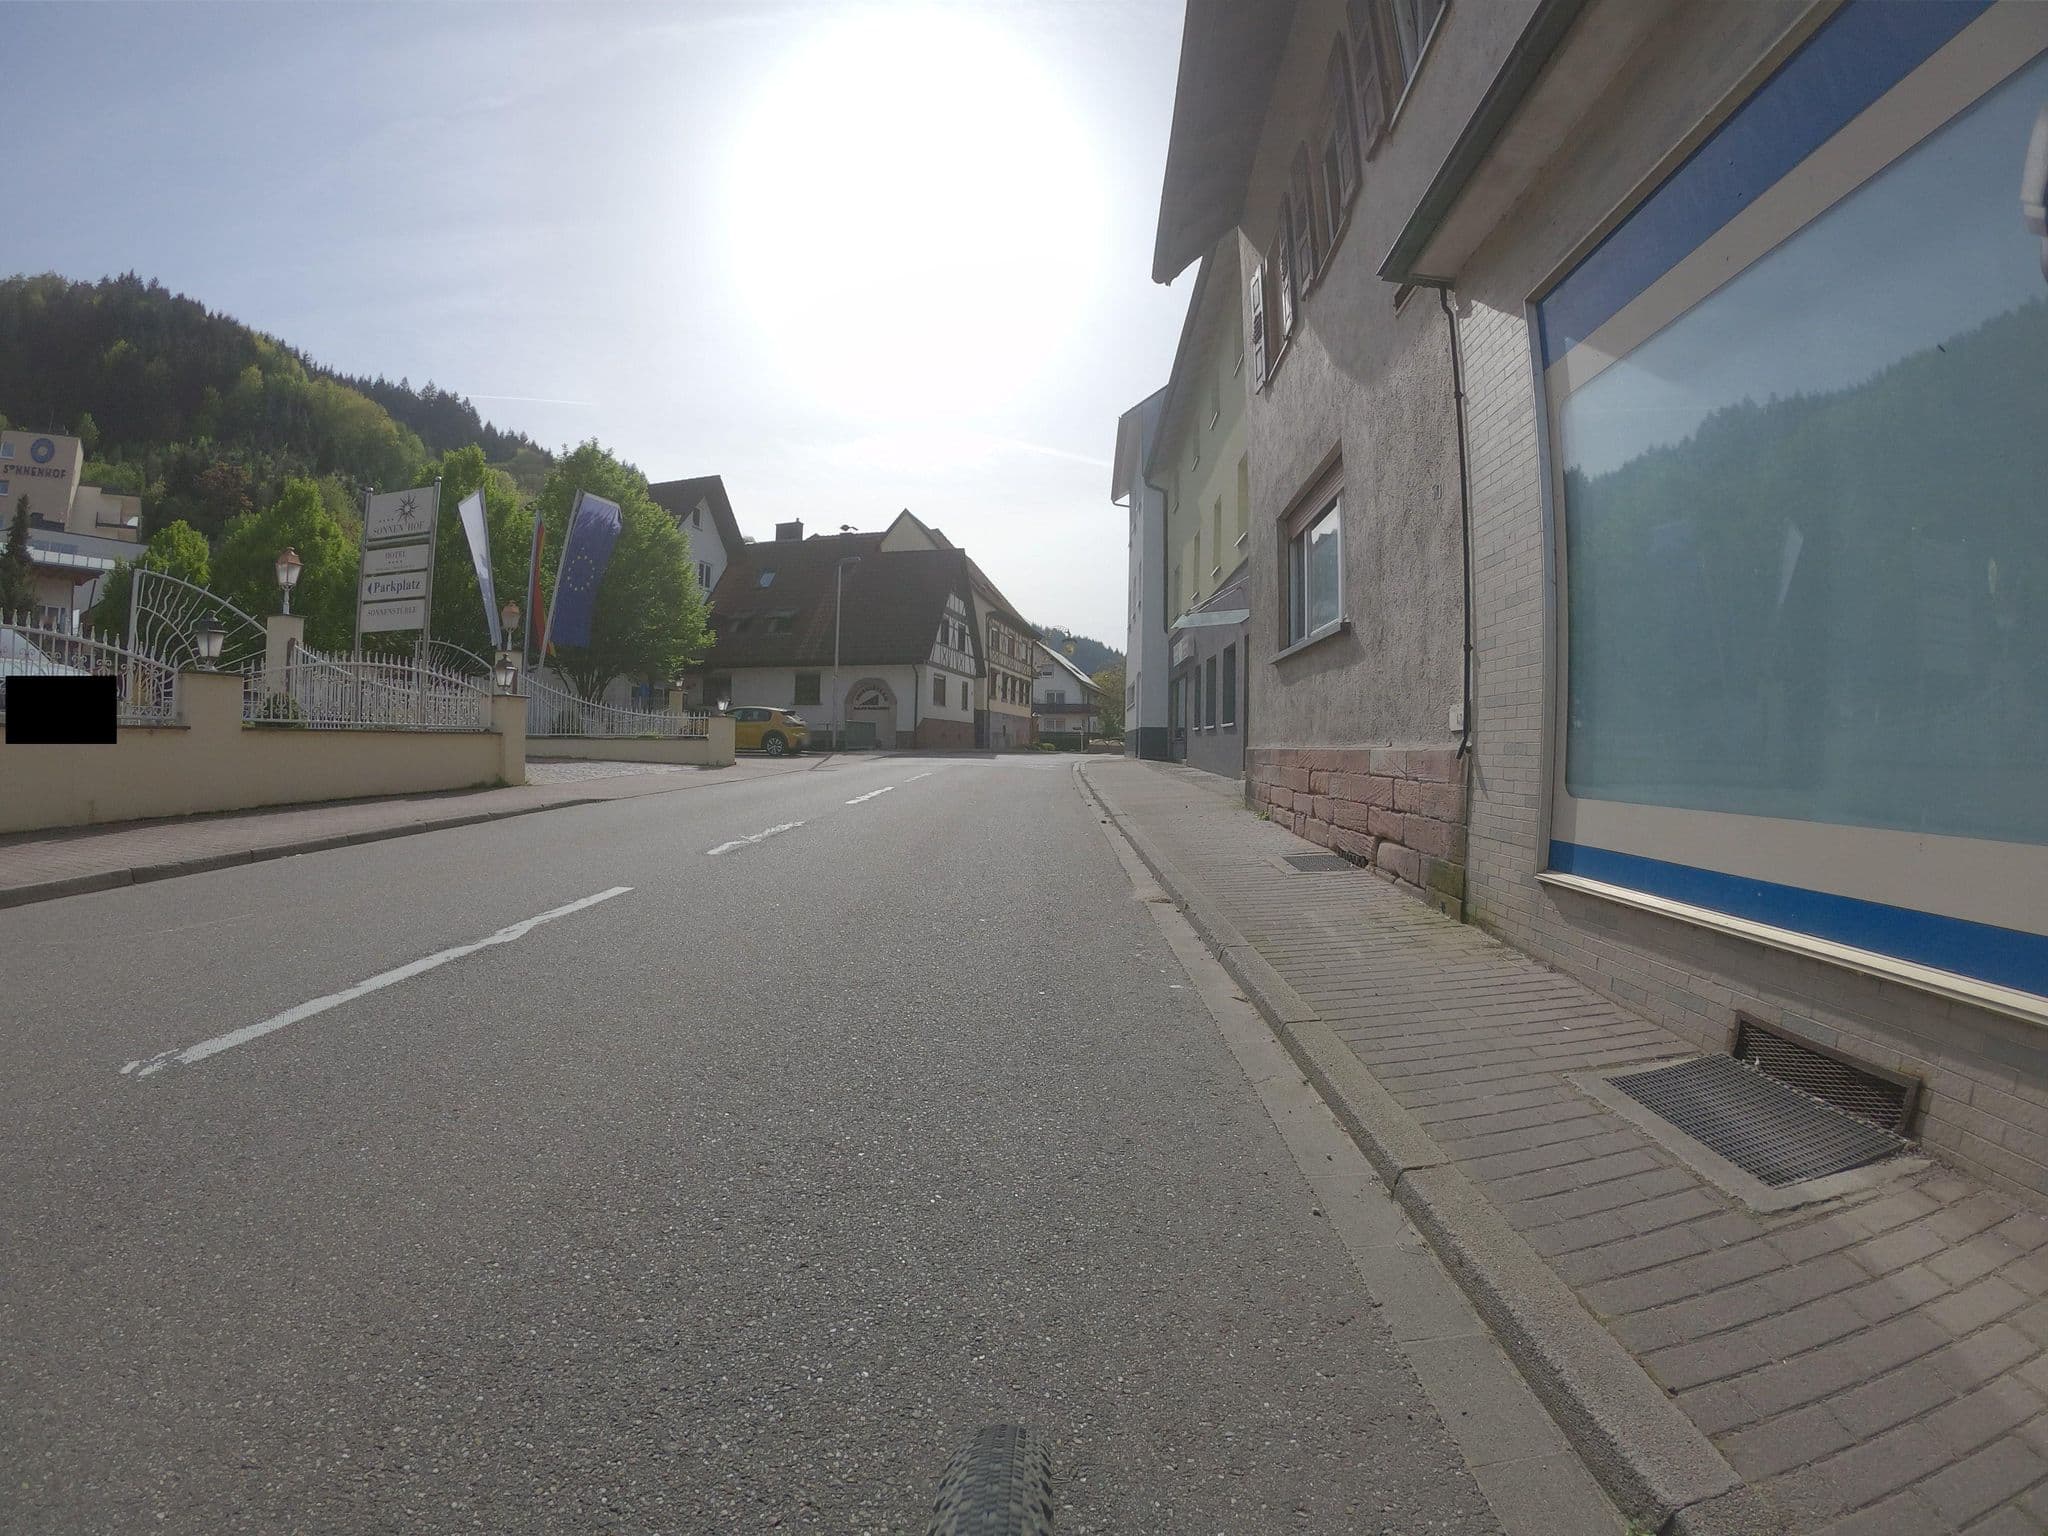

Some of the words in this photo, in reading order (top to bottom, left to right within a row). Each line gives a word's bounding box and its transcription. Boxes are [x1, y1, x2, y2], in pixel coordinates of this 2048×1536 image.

[3, 464, 66, 479] SONNENHOF
[385, 551, 406, 559] HOTEL
[373, 578, 421, 594] Parkplatz
